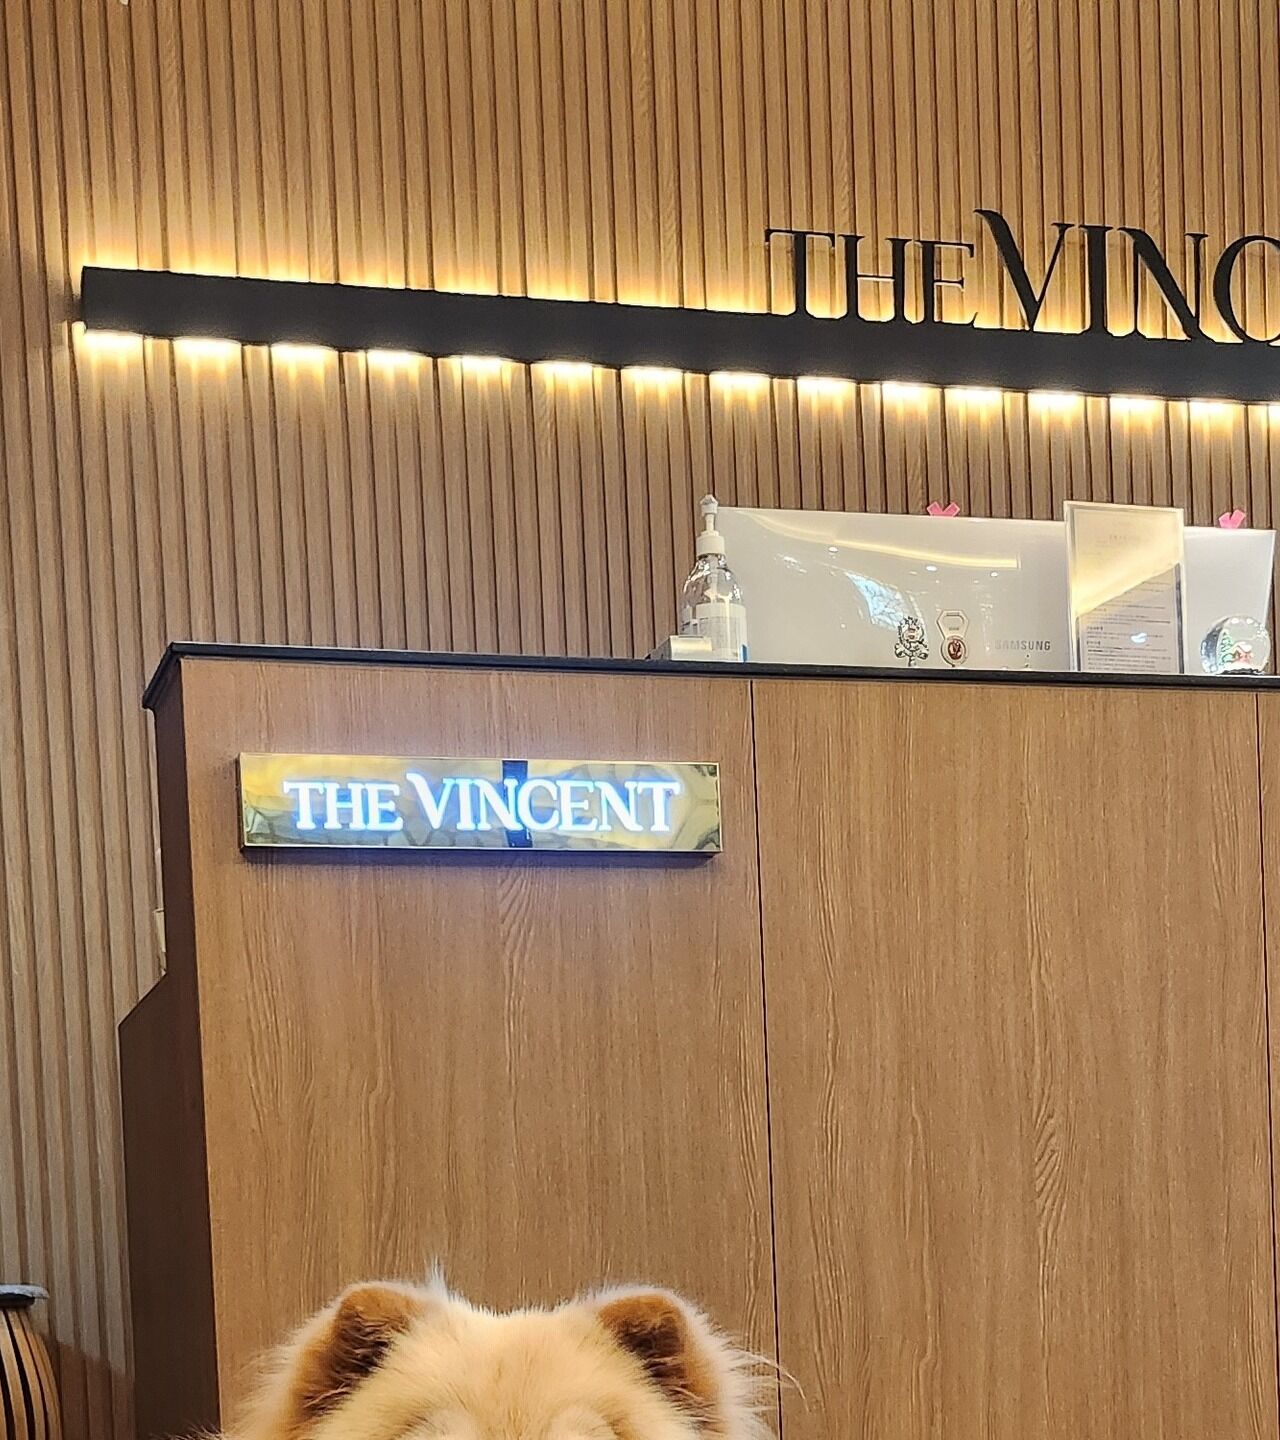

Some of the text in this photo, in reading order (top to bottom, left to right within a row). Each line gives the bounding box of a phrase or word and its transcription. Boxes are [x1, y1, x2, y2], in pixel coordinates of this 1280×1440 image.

[764, 228, 978, 326] THE
[994, 639, 1051, 651] SAMSUNG
[282, 772, 681, 833] THE VINCENT
